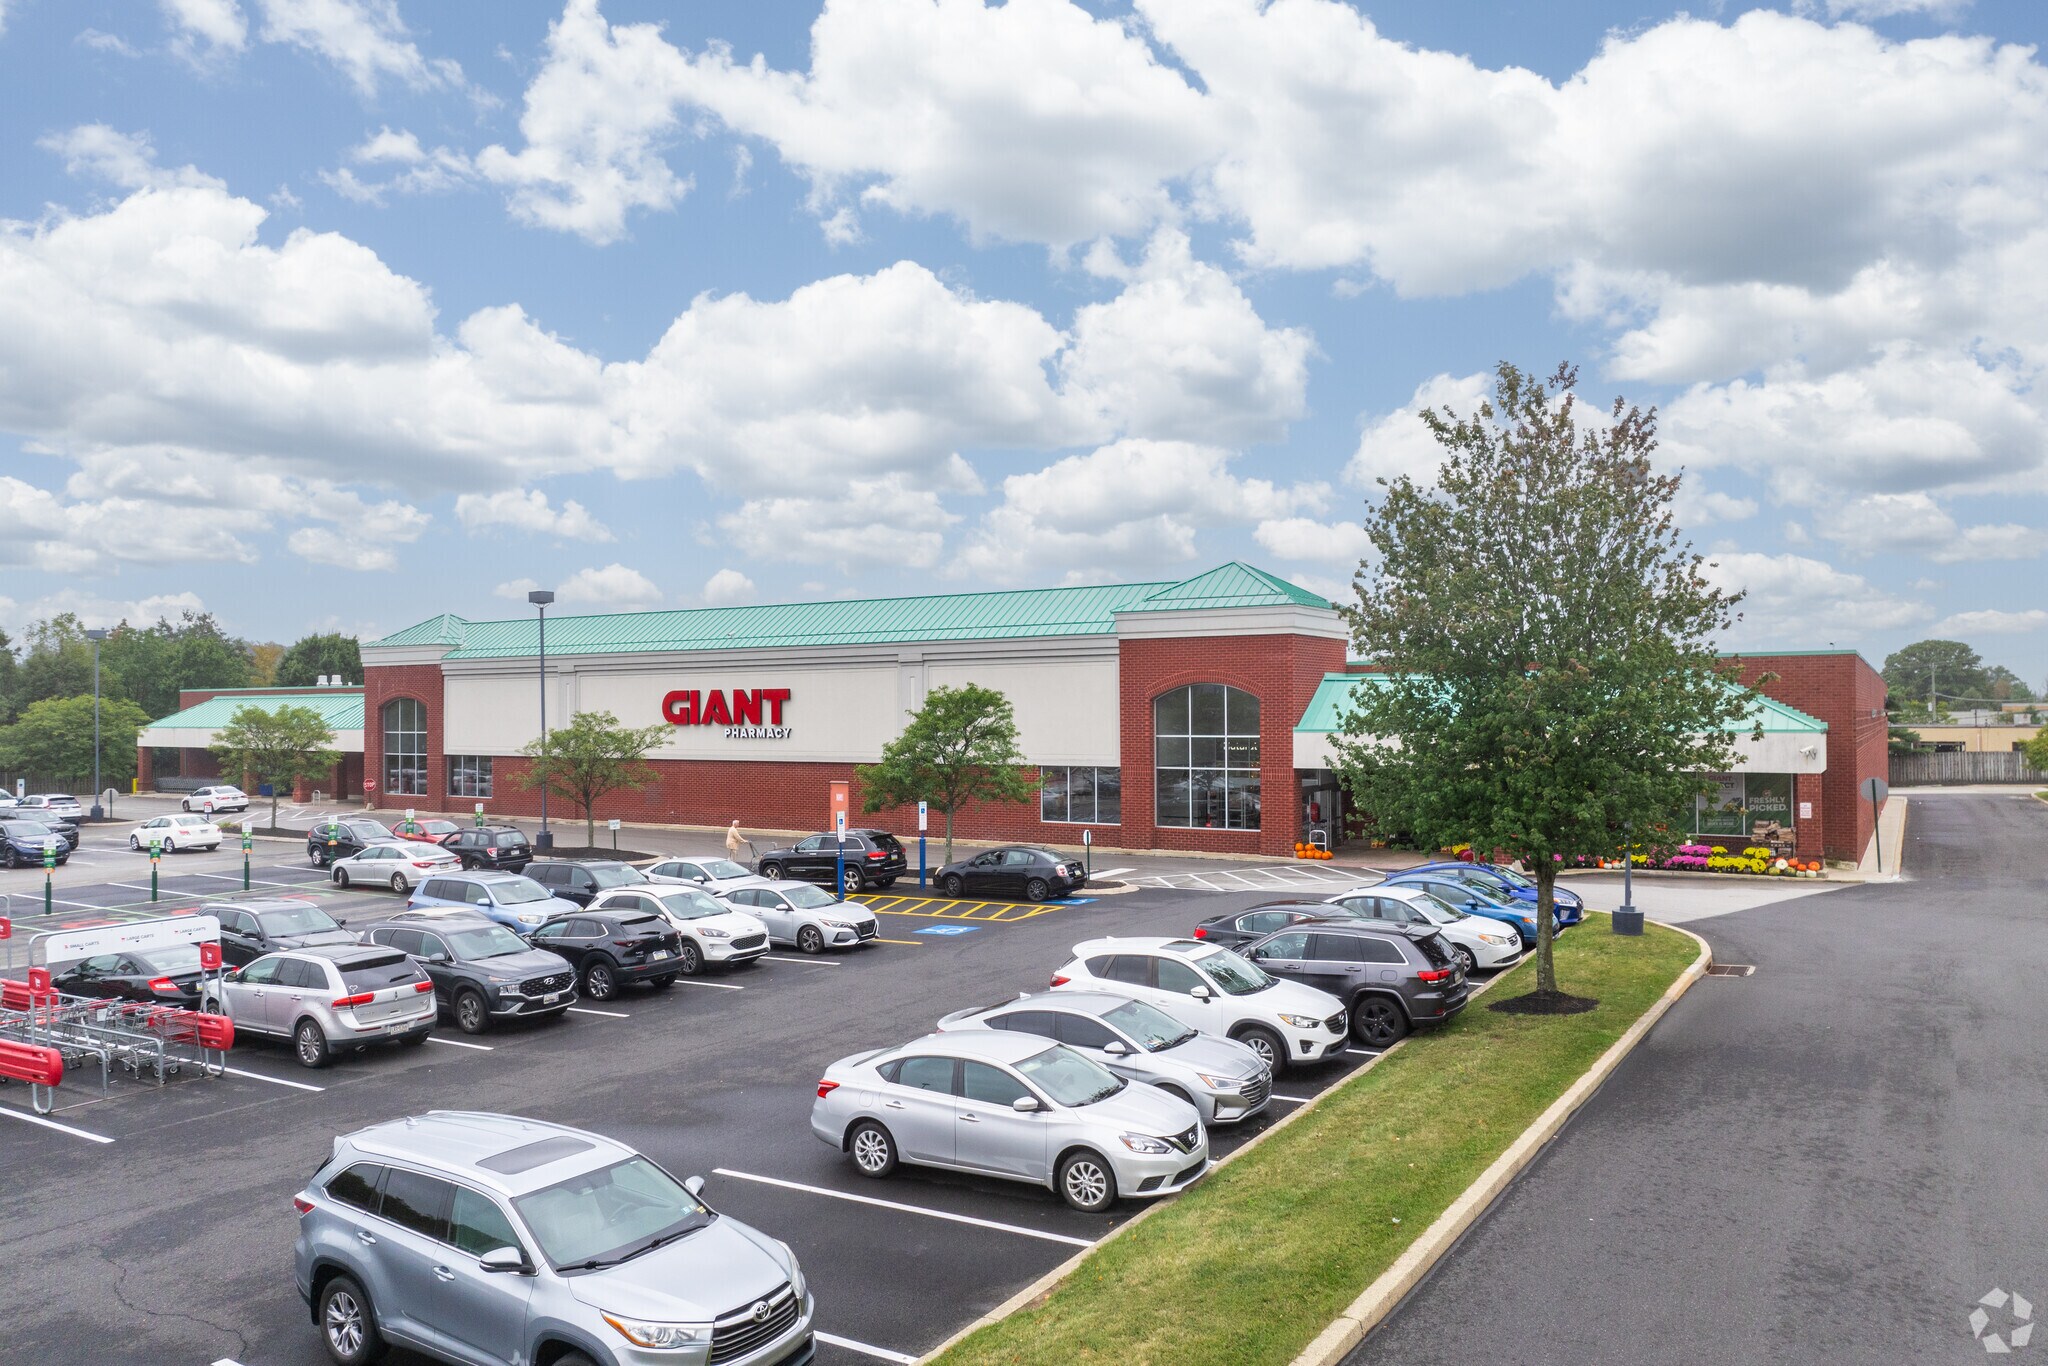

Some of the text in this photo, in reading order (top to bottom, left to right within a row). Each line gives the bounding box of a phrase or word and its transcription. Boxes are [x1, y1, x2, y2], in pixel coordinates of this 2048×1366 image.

[662, 689, 790, 725] GIANT
[724, 728, 791, 738] PHARMACY
[1749, 796, 1786, 804] FRESHLY
[1749, 803, 1788, 811] PICKED.
